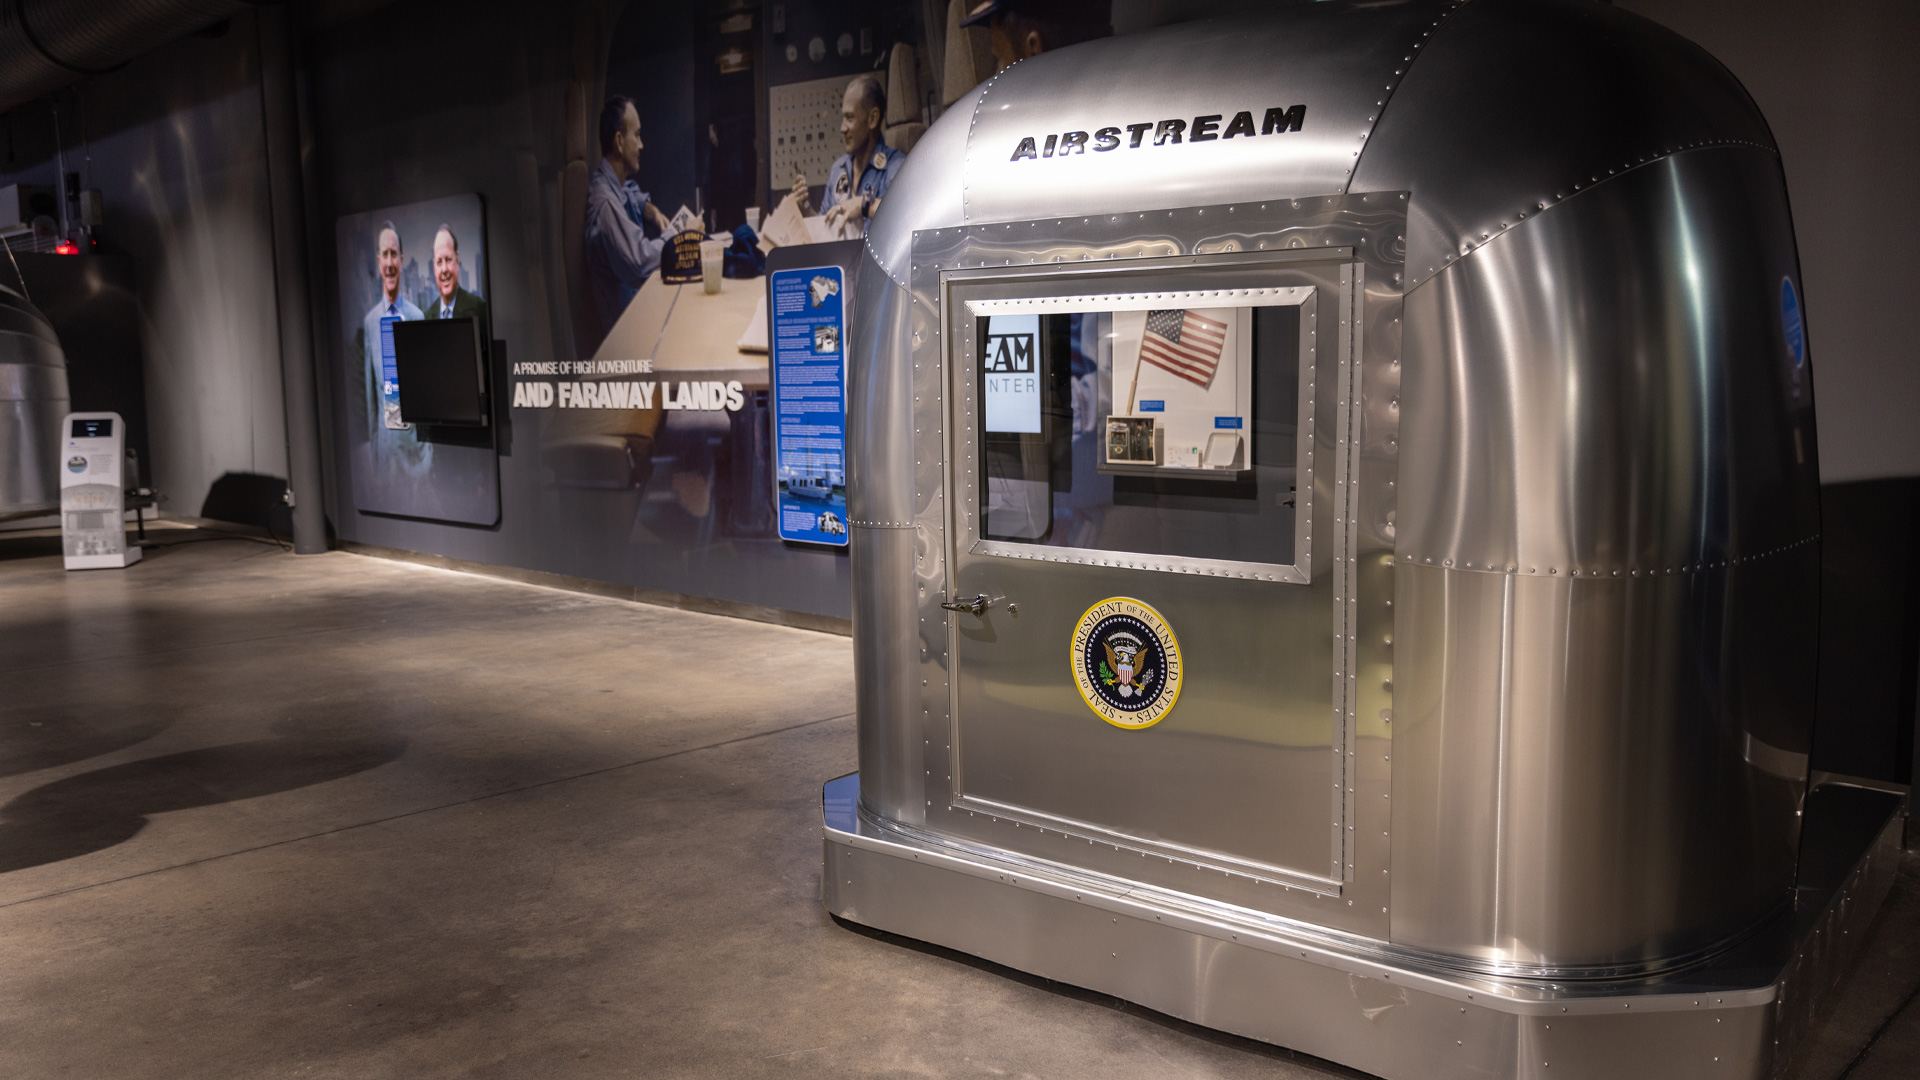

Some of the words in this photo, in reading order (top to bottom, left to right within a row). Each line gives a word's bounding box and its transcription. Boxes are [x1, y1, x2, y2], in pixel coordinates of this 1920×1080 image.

[1010, 104, 1306, 161] AIRSTREAM
[513, 362, 521, 375] A
[521, 361, 558, 375] PROMISE
[559, 361, 572, 374] OF
[573, 360, 595, 374] HIGH
[597, 359, 653, 374] ADVENTURE
[985, 333, 1035, 373] EAM
[513, 382, 554, 408] AND
[558, 381, 656, 410] FARAWAY
[661, 380, 744, 412] LANDS
[989, 378, 1035, 393] NTER
[1126, 605, 1138, 613] OF
[1139, 610, 1154, 624] THE
[1074, 602, 1123, 653] PRESIDENT
[1155, 623, 1179, 681] UNITED
[1080, 677, 1089, 689] OF
[1089, 689, 1116, 719] SEAL
[1136, 686, 1175, 723] STATES
